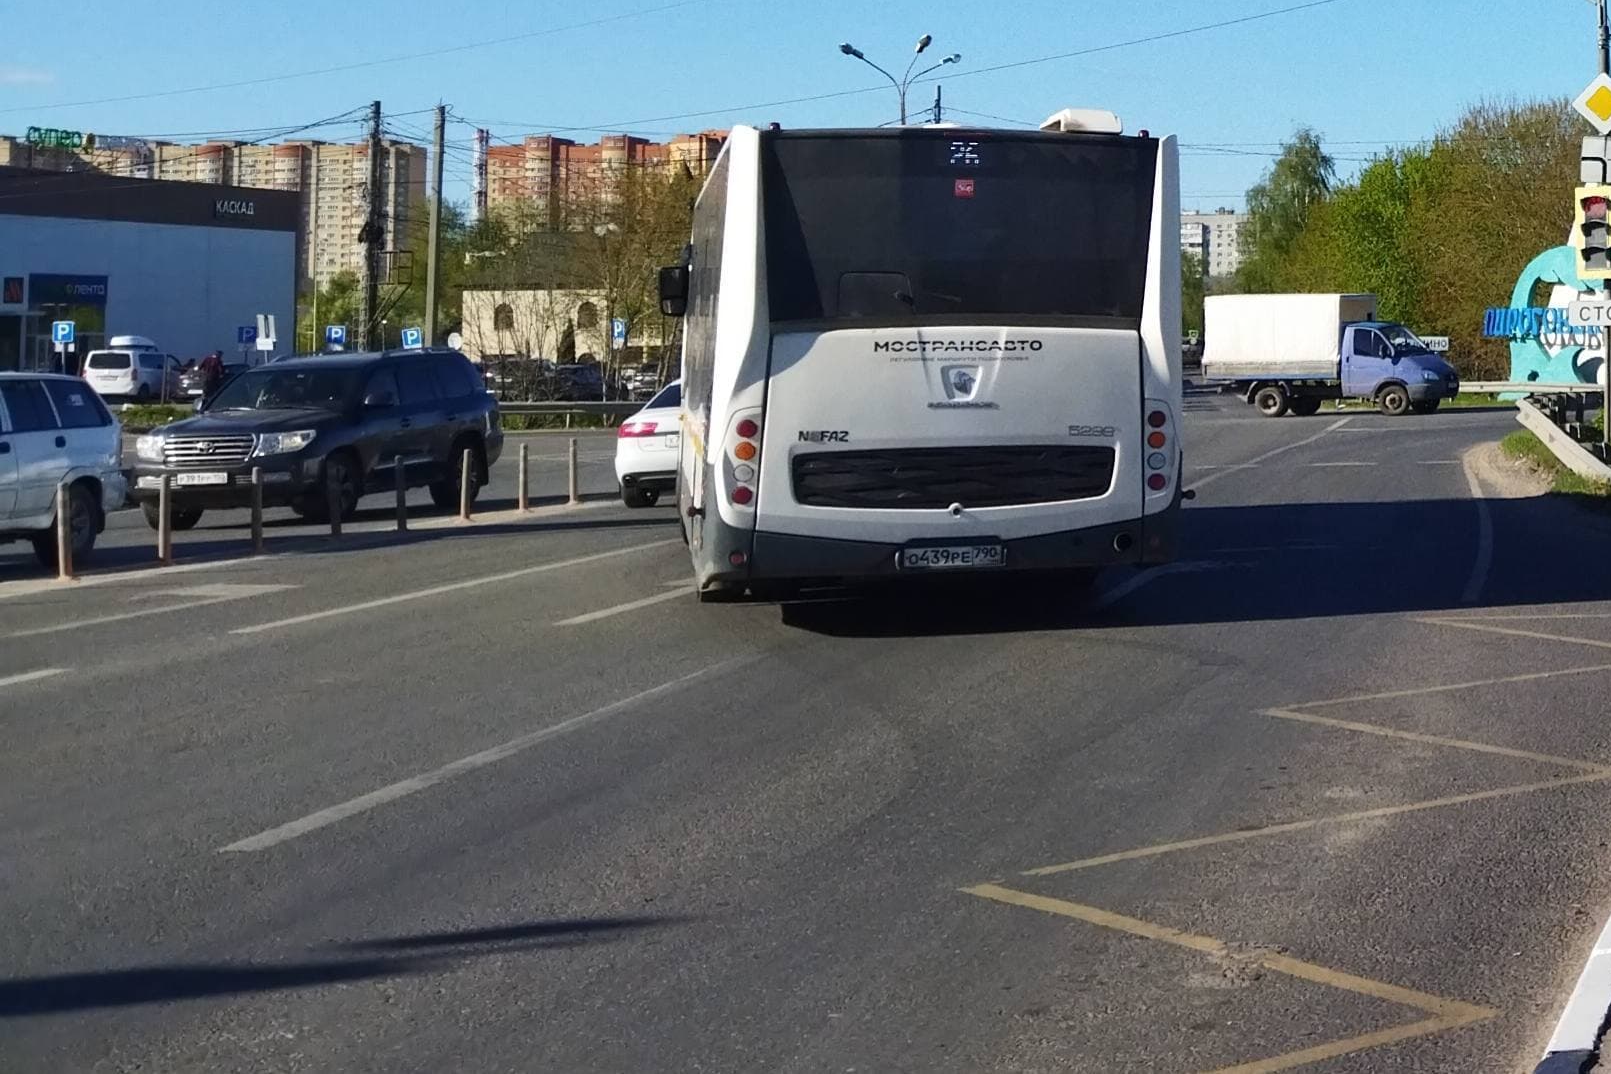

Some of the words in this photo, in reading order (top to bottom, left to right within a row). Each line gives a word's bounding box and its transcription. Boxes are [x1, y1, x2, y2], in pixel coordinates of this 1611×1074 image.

[215, 199, 255, 215] КАСКАД
[874, 340, 1043, 352] МОСТРАНСАВТО
[974, 547, 998, 559] 790
